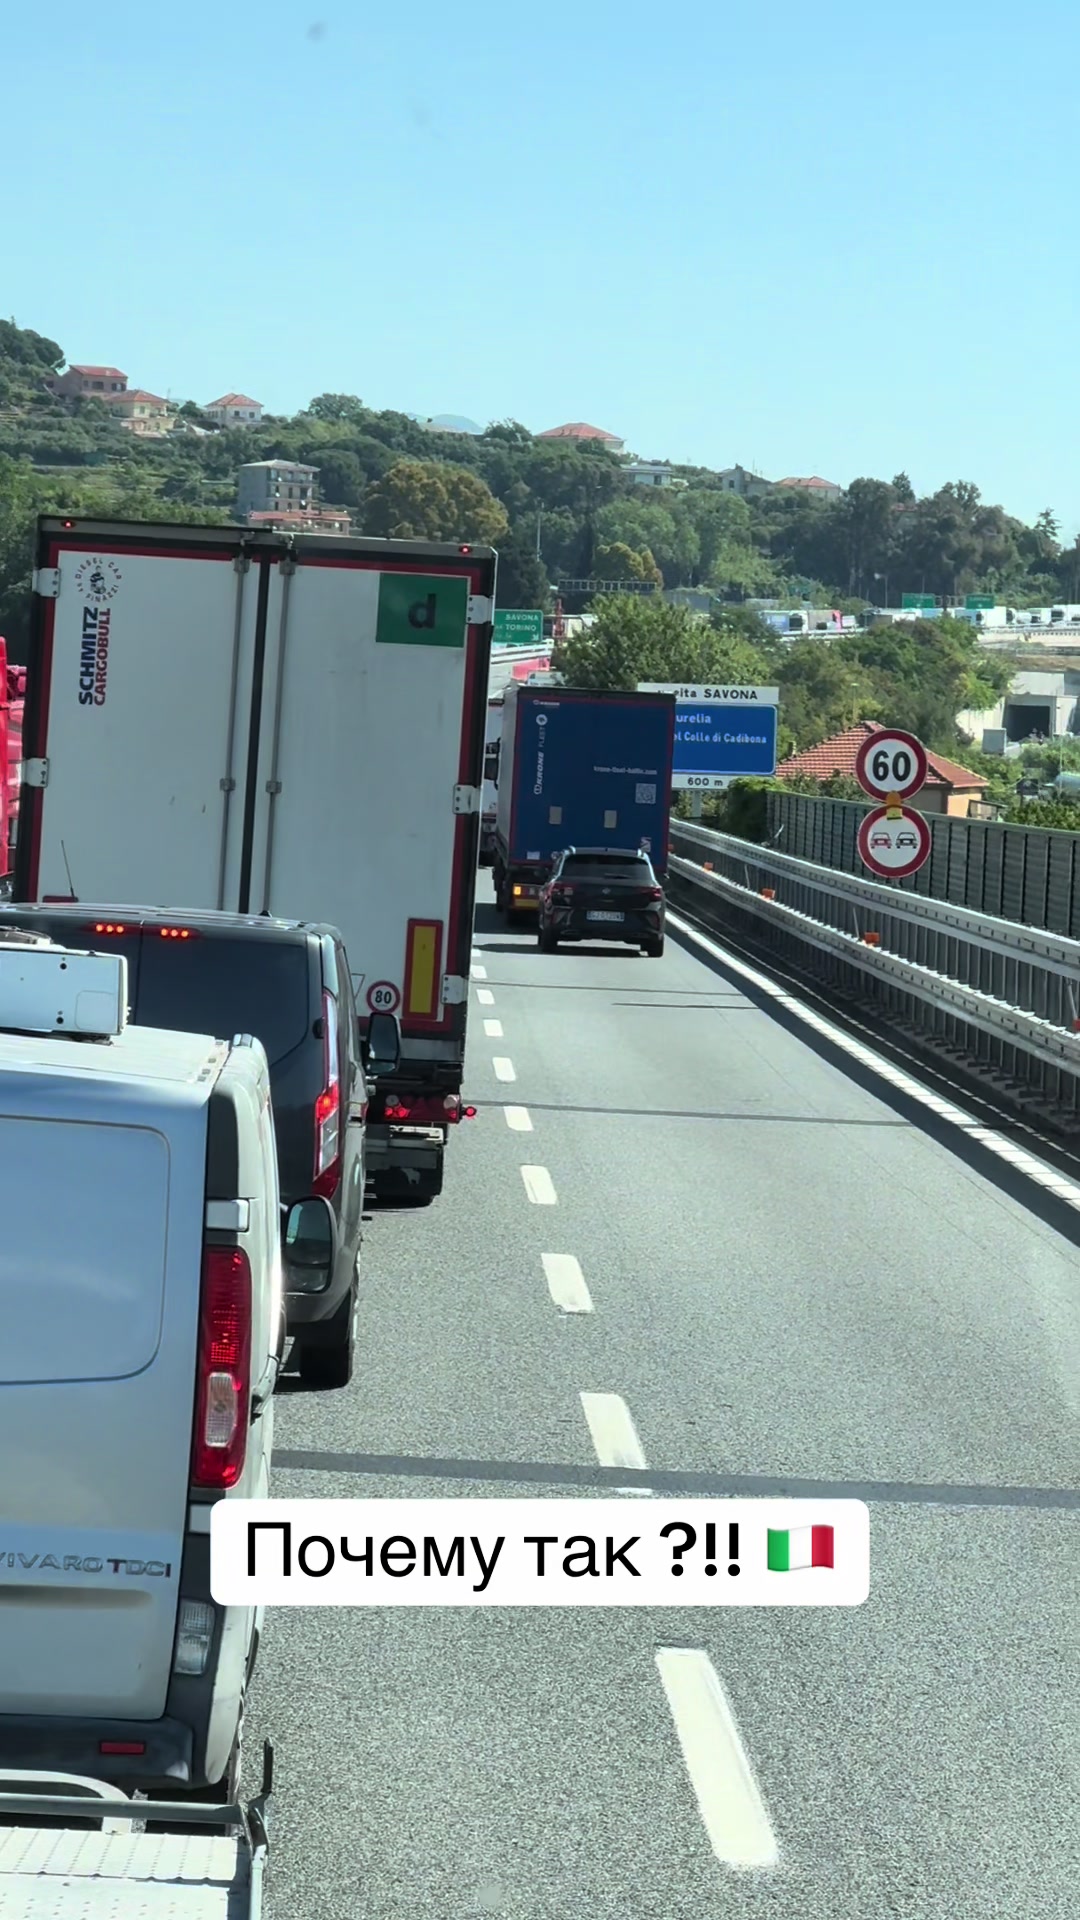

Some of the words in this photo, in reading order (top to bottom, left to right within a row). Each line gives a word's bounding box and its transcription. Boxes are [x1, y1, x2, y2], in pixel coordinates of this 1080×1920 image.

[505, 613, 539, 621] SAVONA
[505, 623, 537, 631] TORINO
[78, 606, 98, 705] SCHMITZ
[94, 608, 111, 706] CARGOBULL
[703, 689, 758, 700] SAVONA
[675, 713, 712, 724] urelia
[684, 731, 710, 742] Colle
[712, 732, 721, 743] di
[723, 733, 767, 744] Cadibona
[872, 750, 911, 782] 60
[687, 777, 710, 786] 600
[374, 990, 392, 1004] 80
[106, 1558, 172, 1578] TDCI
